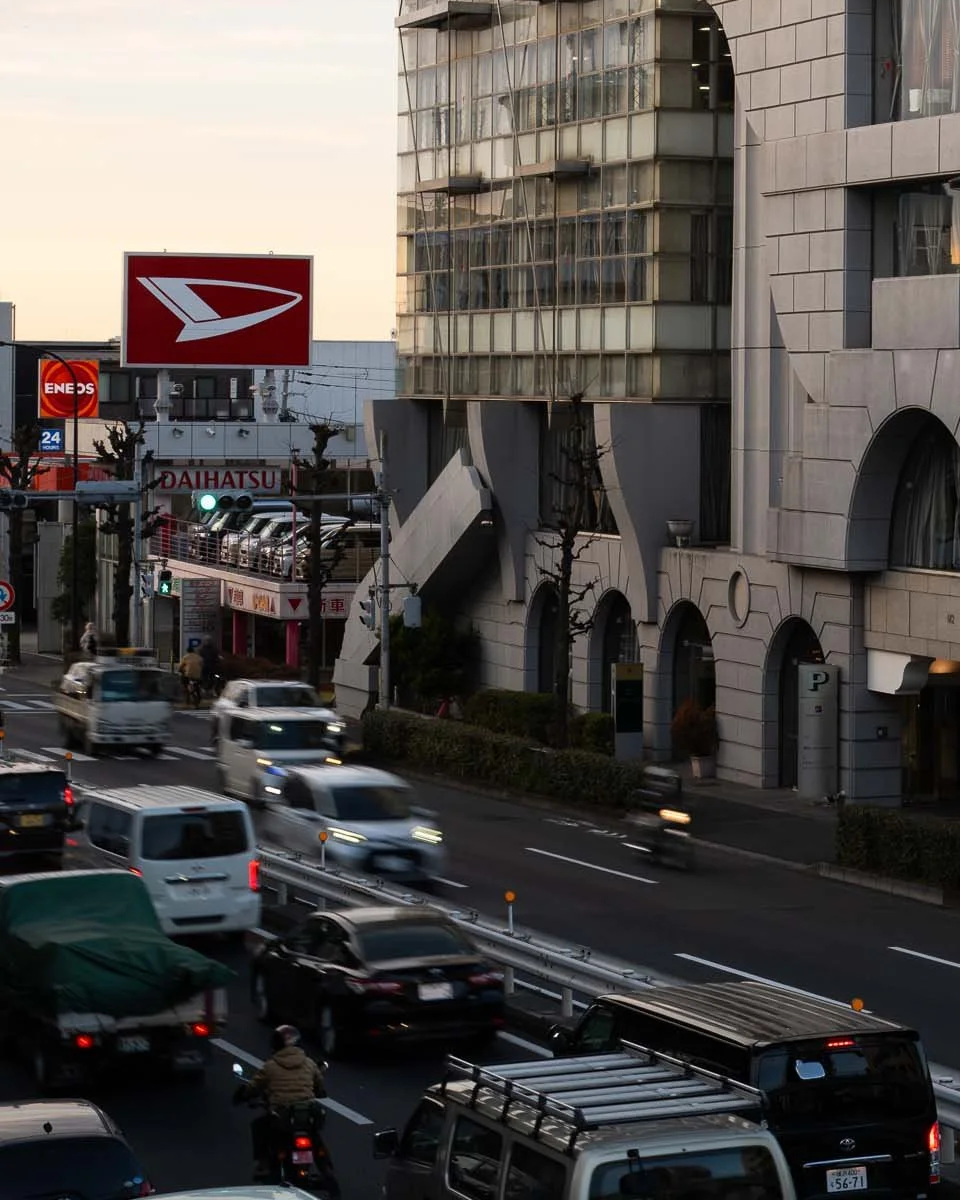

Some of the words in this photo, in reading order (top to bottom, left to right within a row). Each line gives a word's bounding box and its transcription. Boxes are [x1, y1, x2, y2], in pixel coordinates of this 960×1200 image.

[44, 382, 95, 395] ENEOS
[41, 431, 61, 444] 24
[159, 470, 276, 489] DAIHATSU
[807, 670, 829, 692] P
[835, 1175, 864, 1190] 56-71
